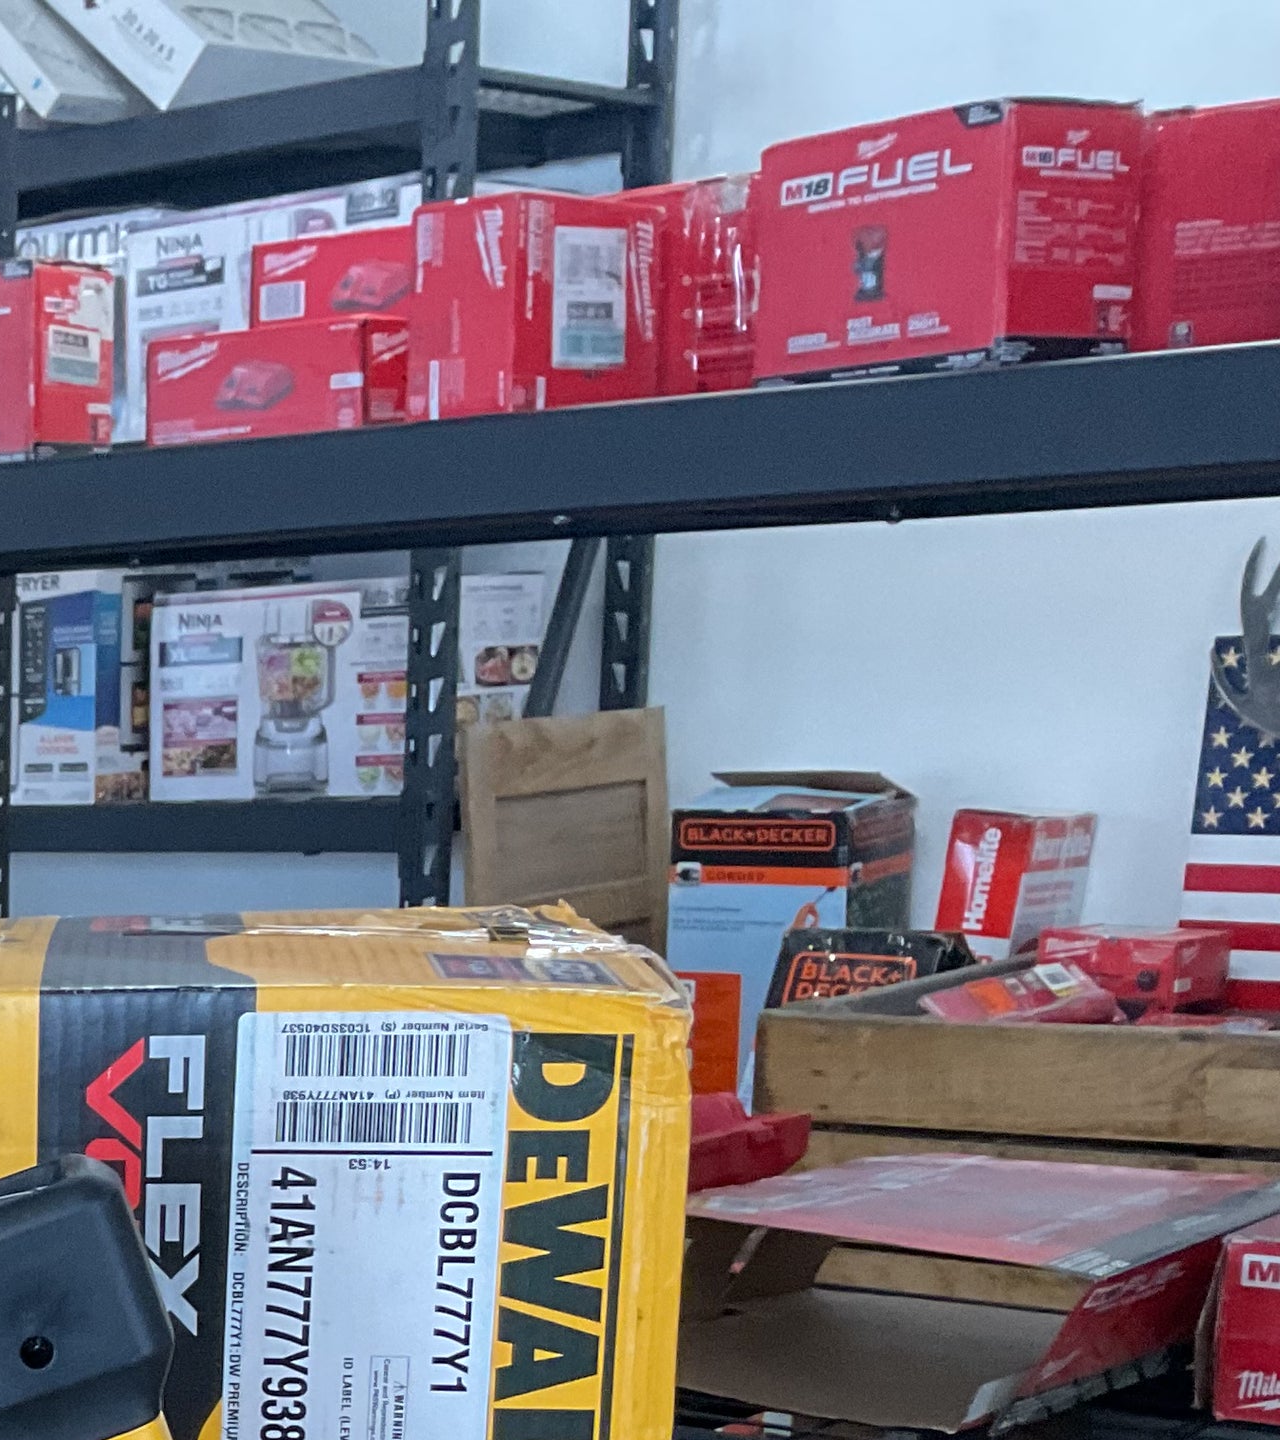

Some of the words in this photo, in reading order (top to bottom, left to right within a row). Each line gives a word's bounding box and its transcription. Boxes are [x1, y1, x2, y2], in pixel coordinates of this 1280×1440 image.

[1056, 148, 1130, 172] FUEL
[786, 178, 829, 200] M18
[837, 149, 974, 195] FUEL
[178, 613, 223, 632] NINJA
[688, 827, 829, 844] BLACK+DECKER
[961, 826, 1002, 929] Homelite
[799, 958, 903, 985] BLACK+
[380, 1020, 397, 1031] (S)
[400, 1021, 449, 1031] Number
[281, 1088, 374, 1100] 41AN777Y938
[383, 1088, 400, 1100] (P)
[404, 1089, 453, 1100] Number
[347, 1157, 391, 1169] 14:53
[144, 1034, 207, 1338] FLEX
[232, 1161, 249, 1258] DESCRIPTION:
[429, 1171, 481, 1393] DCBL777Y1
[226, 1271, 246, 1378] DCBL777Y1:DW
[341, 1356, 354, 1370] ID
[339, 1374, 353, 1411] LABEL
